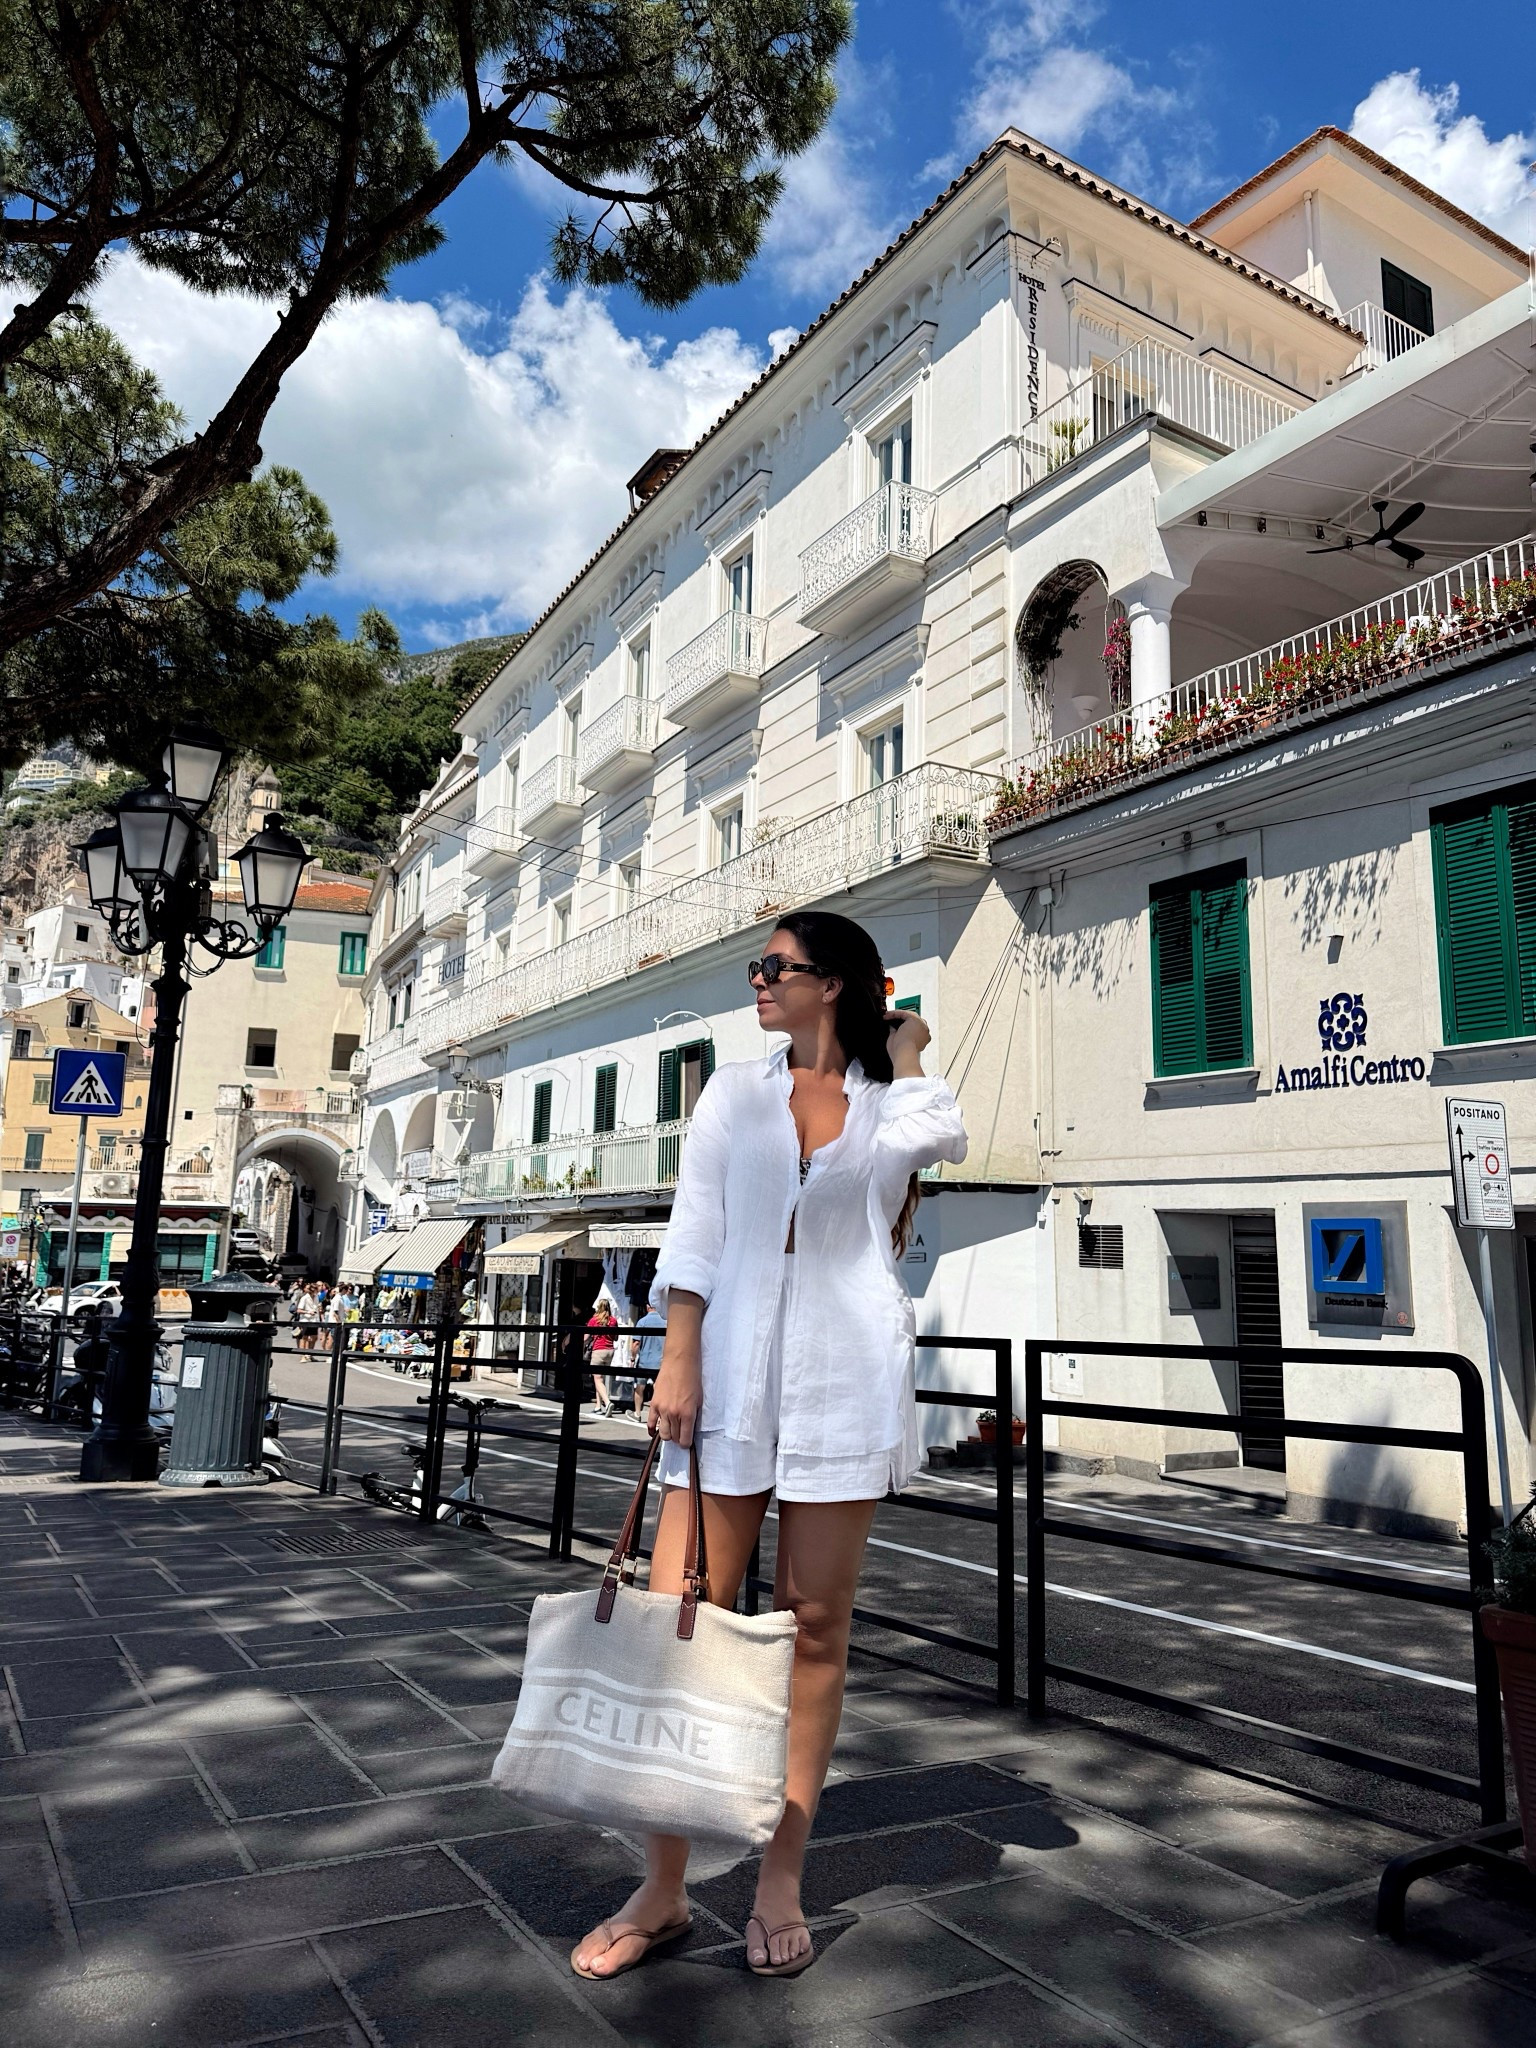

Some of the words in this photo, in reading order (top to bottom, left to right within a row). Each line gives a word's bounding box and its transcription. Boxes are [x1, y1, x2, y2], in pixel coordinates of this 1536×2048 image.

[1018, 272, 1047, 292] HOTEL
[1027, 286, 1040, 423] RESIDENCE
[1275, 1054, 1349, 1093] Amalfi
[1350, 1055, 1425, 1086] Centro
[1453, 1106, 1500, 1120] POSITANO
[1325, 1297, 1364, 1306] Deutsche
[554, 1691, 714, 1761] CELINE
